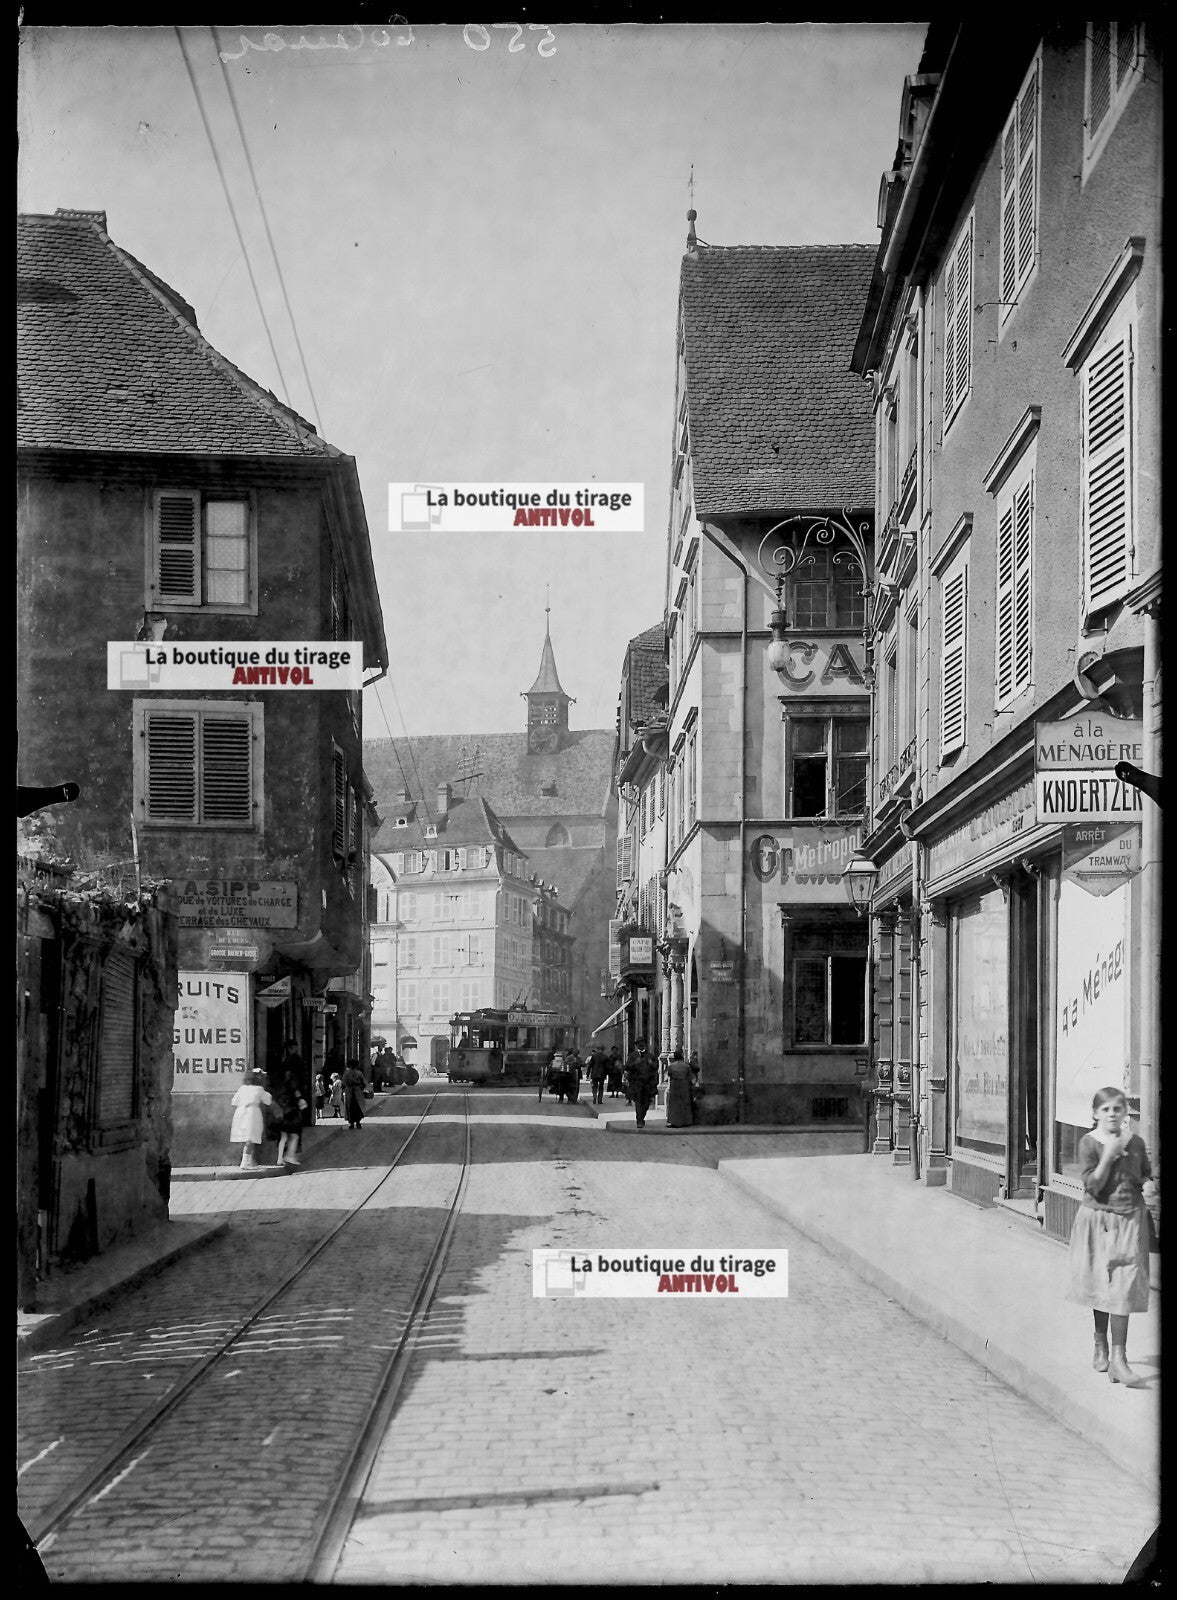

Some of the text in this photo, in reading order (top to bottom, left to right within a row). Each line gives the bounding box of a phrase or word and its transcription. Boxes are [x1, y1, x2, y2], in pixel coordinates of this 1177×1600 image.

[1038, 740, 1143, 762] MÉNAGÈRE
[1043, 779, 1143, 813] KNOERTZER
[1076, 827, 1106, 841] ARRÊT
[1119, 840, 1132, 850] DU
[1089, 856, 1132, 867] TRAMWAY
[206, 896, 248, 906] VOITURES
[258, 898, 292, 907] CHARGE
